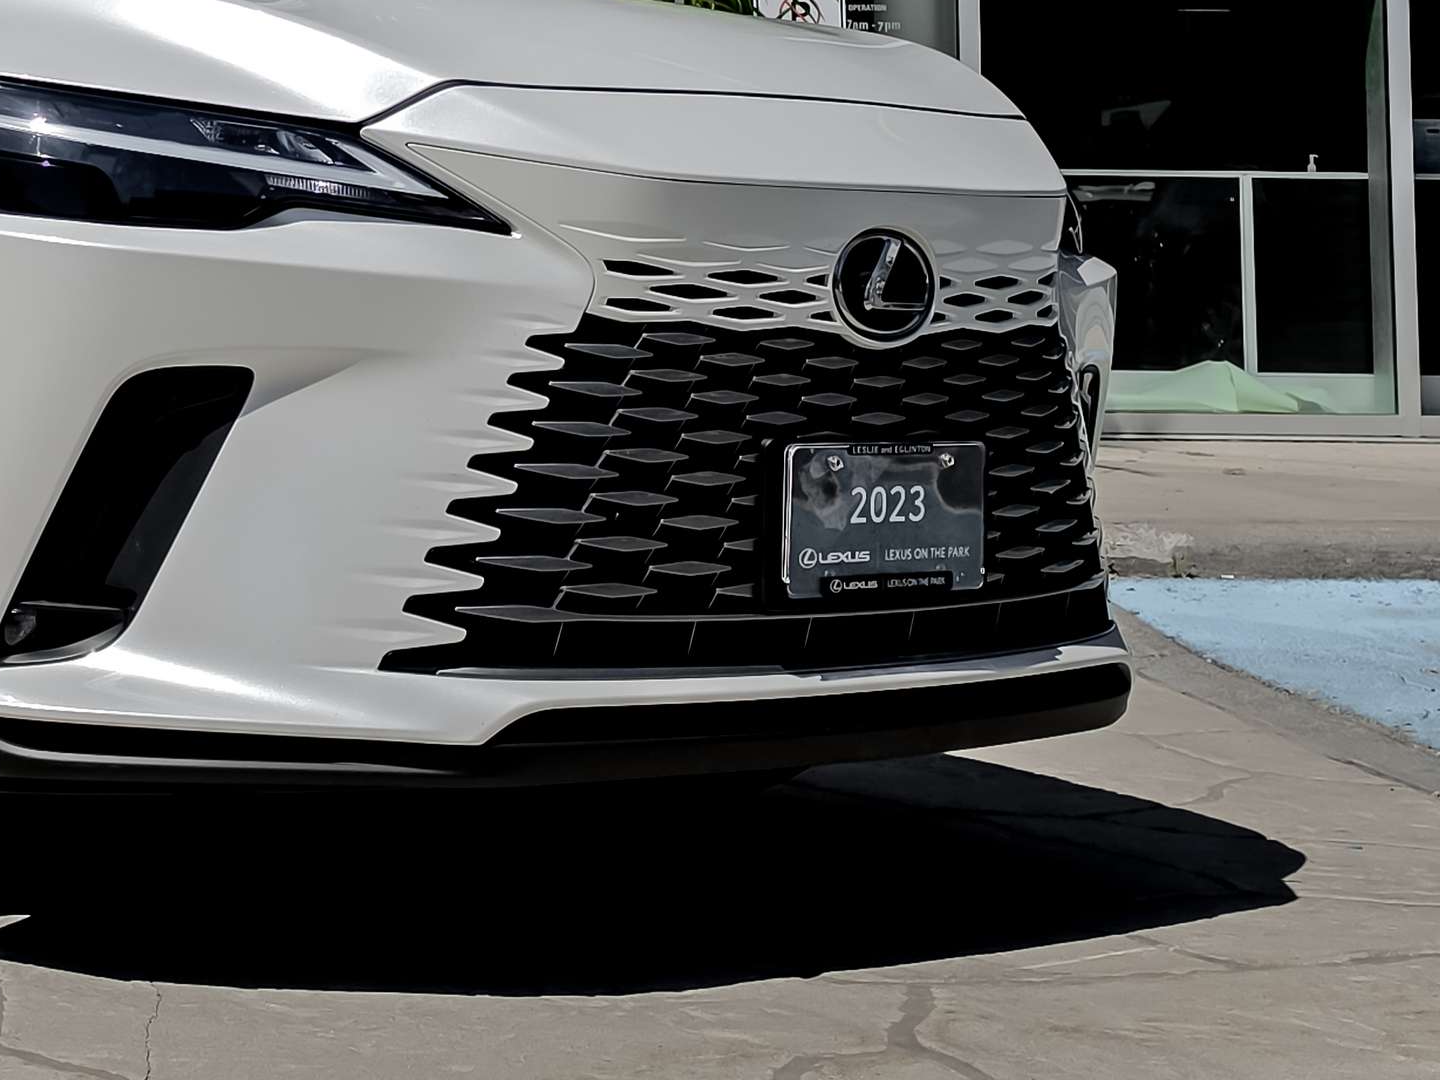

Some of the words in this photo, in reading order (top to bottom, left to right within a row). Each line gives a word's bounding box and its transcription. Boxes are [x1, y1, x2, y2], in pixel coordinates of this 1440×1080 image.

[847, 4, 888, 12] OPERATION
[852, 445, 879, 454] LESLIE
[881, 445, 893, 454] and
[849, 485, 926, 524] 2023
[818, 550, 871, 565] LEXUS
[884, 548, 912, 561] LEXUS
[914, 547, 929, 560] ON
[930, 547, 946, 559] THE
[947, 546, 971, 558] PARK
[843, 579, 878, 590] LEXUS
